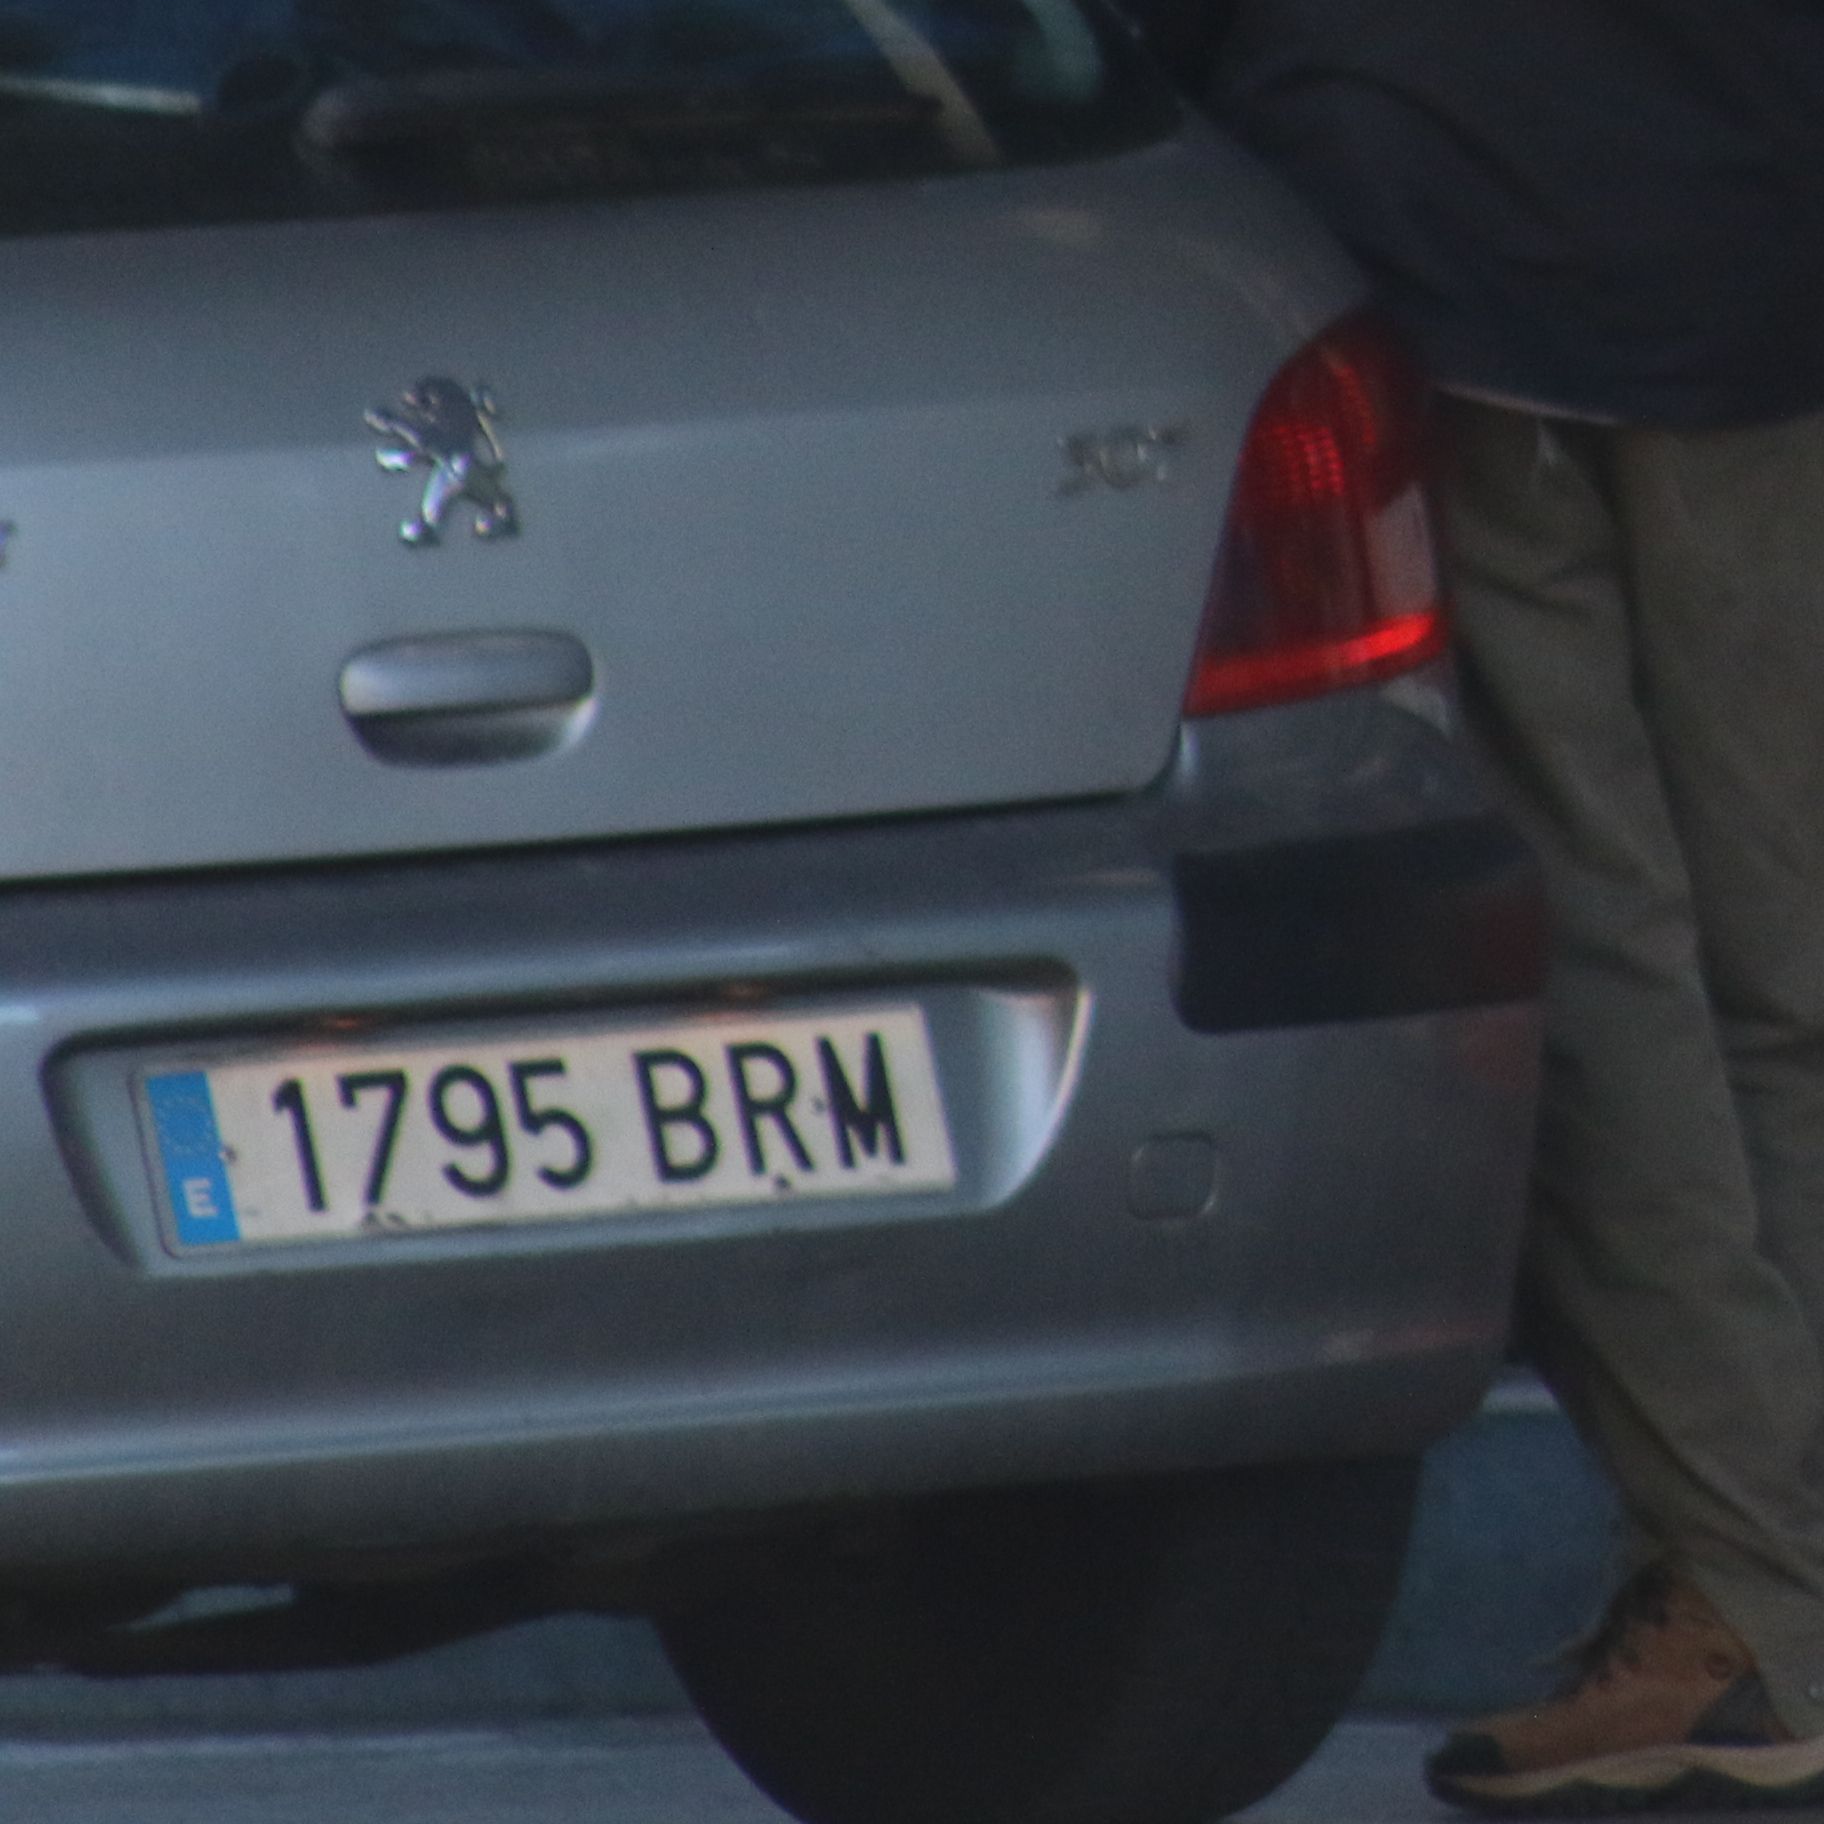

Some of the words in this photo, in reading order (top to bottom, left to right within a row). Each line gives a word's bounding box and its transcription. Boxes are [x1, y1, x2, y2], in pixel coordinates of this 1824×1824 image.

[273, 1056, 592, 1212] 1795
[633, 1033, 906, 1183] BRM
[183, 1178, 219, 1217] E
